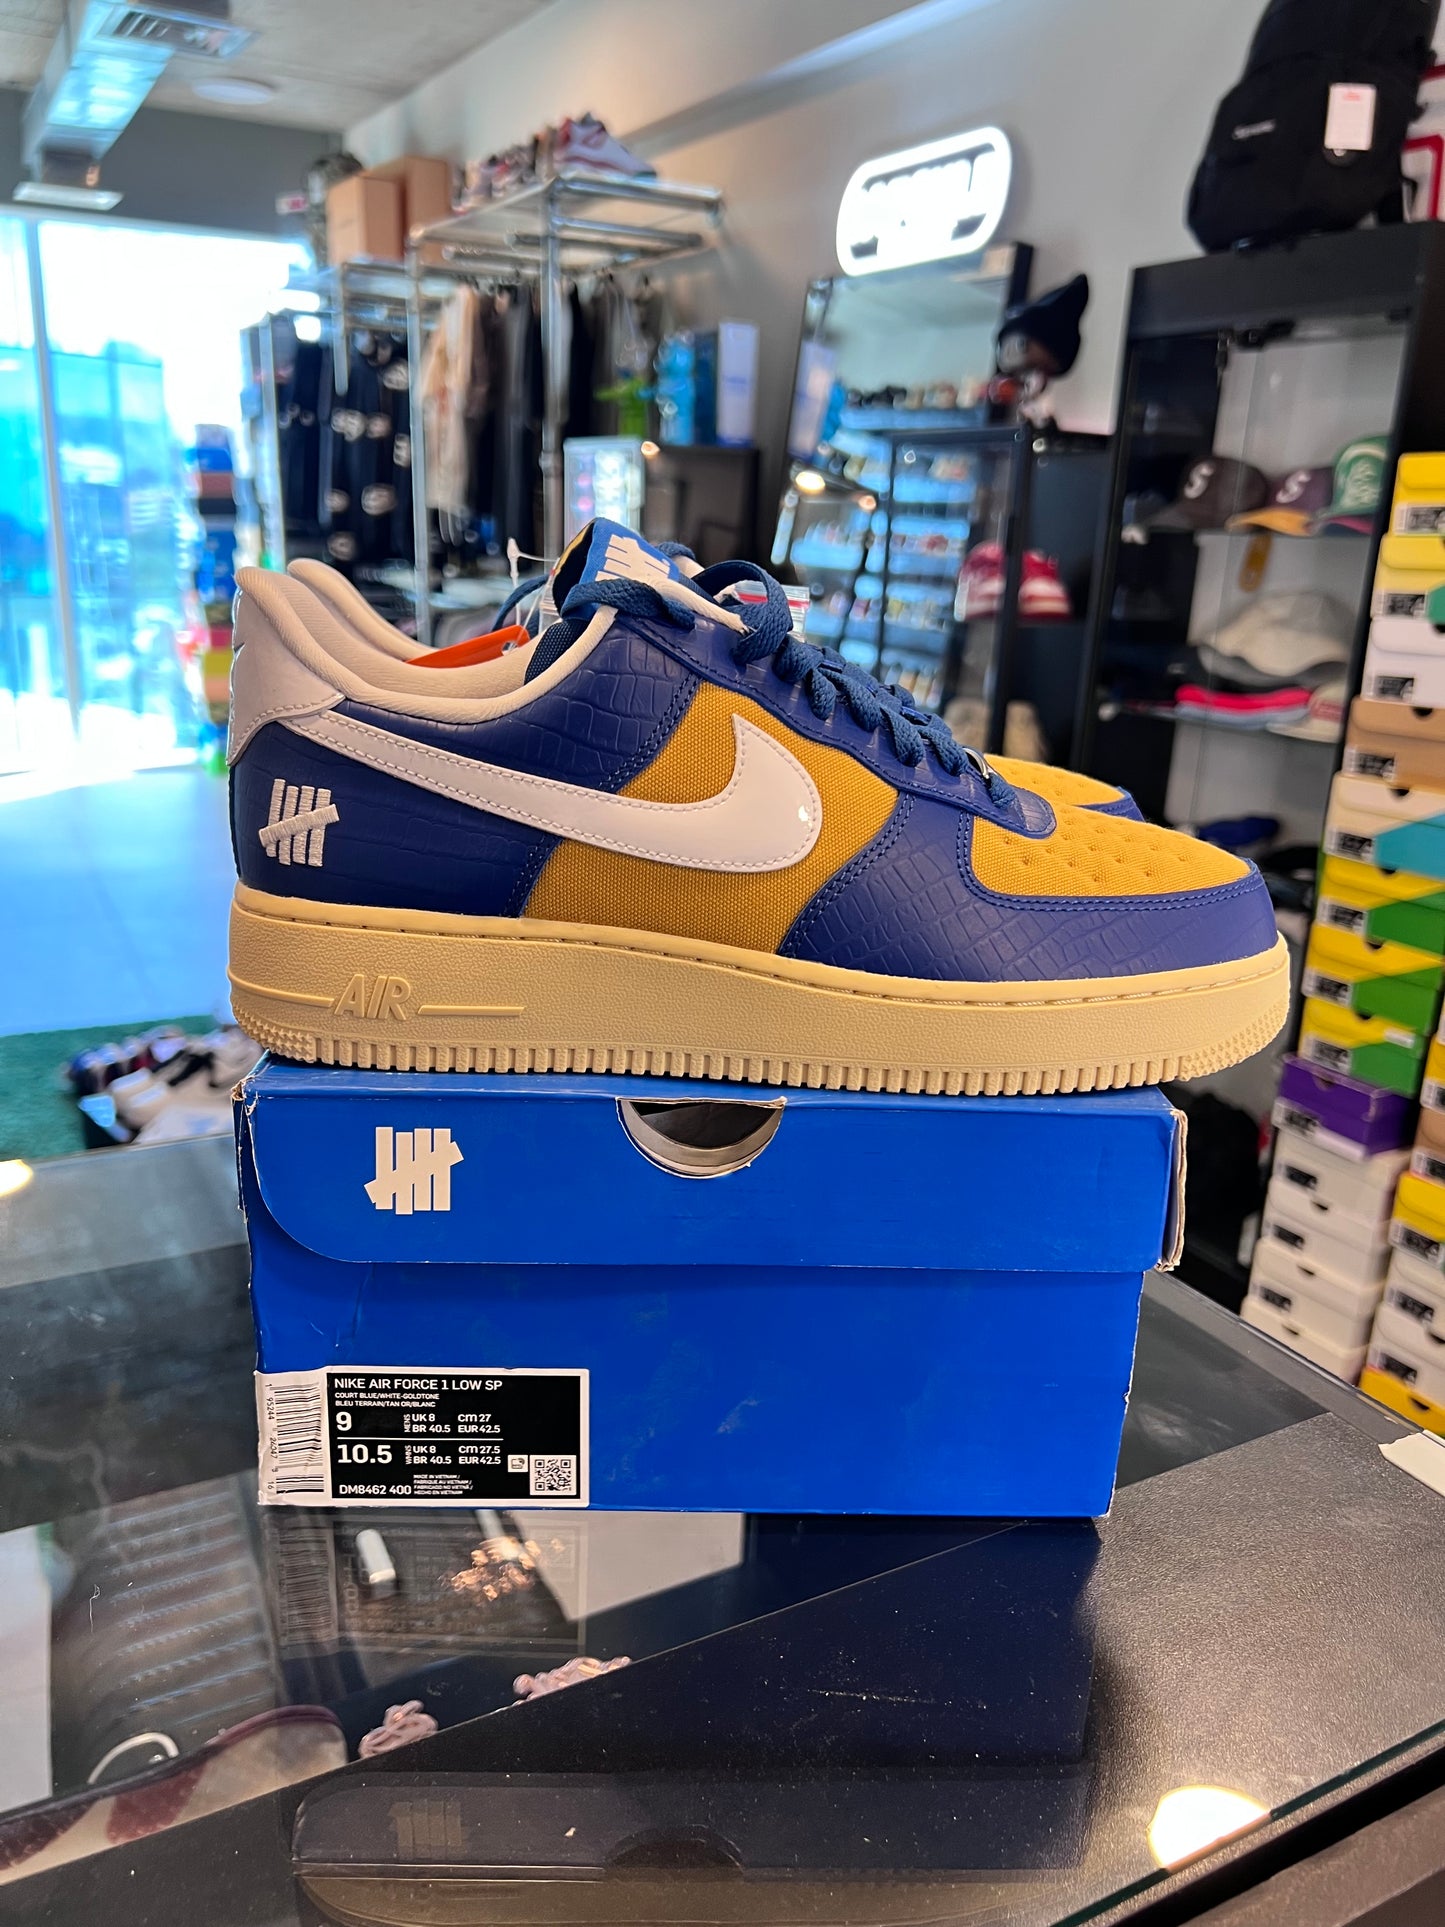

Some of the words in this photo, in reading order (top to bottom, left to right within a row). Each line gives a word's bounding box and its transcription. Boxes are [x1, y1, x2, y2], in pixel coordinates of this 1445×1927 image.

[334, 973, 411, 1021] AIR
[335, 1378, 366, 1389] NIKE
[369, 1378, 391, 1389] AIR
[394, 1379, 438, 1390] FORCE
[441, 1379, 449, 1390] 1
[452, 1379, 482, 1390] LOW
[485, 1380, 503, 1391] SP
[335, 1411, 352, 1431] 9
[411, 1413, 427, 1422] UK
[428, 1413, 436, 1422] 8
[479, 1414, 492, 1422] 27
[412, 1424, 427, 1433] BR
[428, 1424, 451, 1433] 40.5
[457, 1424, 479, 1433] EUR
[478, 1424, 501, 1433] 42.5
[337, 1443, 393, 1464] 10.5
[412, 1445, 428, 1454] UK
[429, 1445, 437, 1454] 8
[479, 1445, 501, 1454] 27.5
[413, 1456, 428, 1465] BR
[429, 1456, 452, 1465] 40.5
[458, 1456, 480, 1465] EUR
[479, 1456, 501, 1465] 42.5
[339, 1484, 387, 1495] DM8462
[389, 1485, 412, 1495] 400
